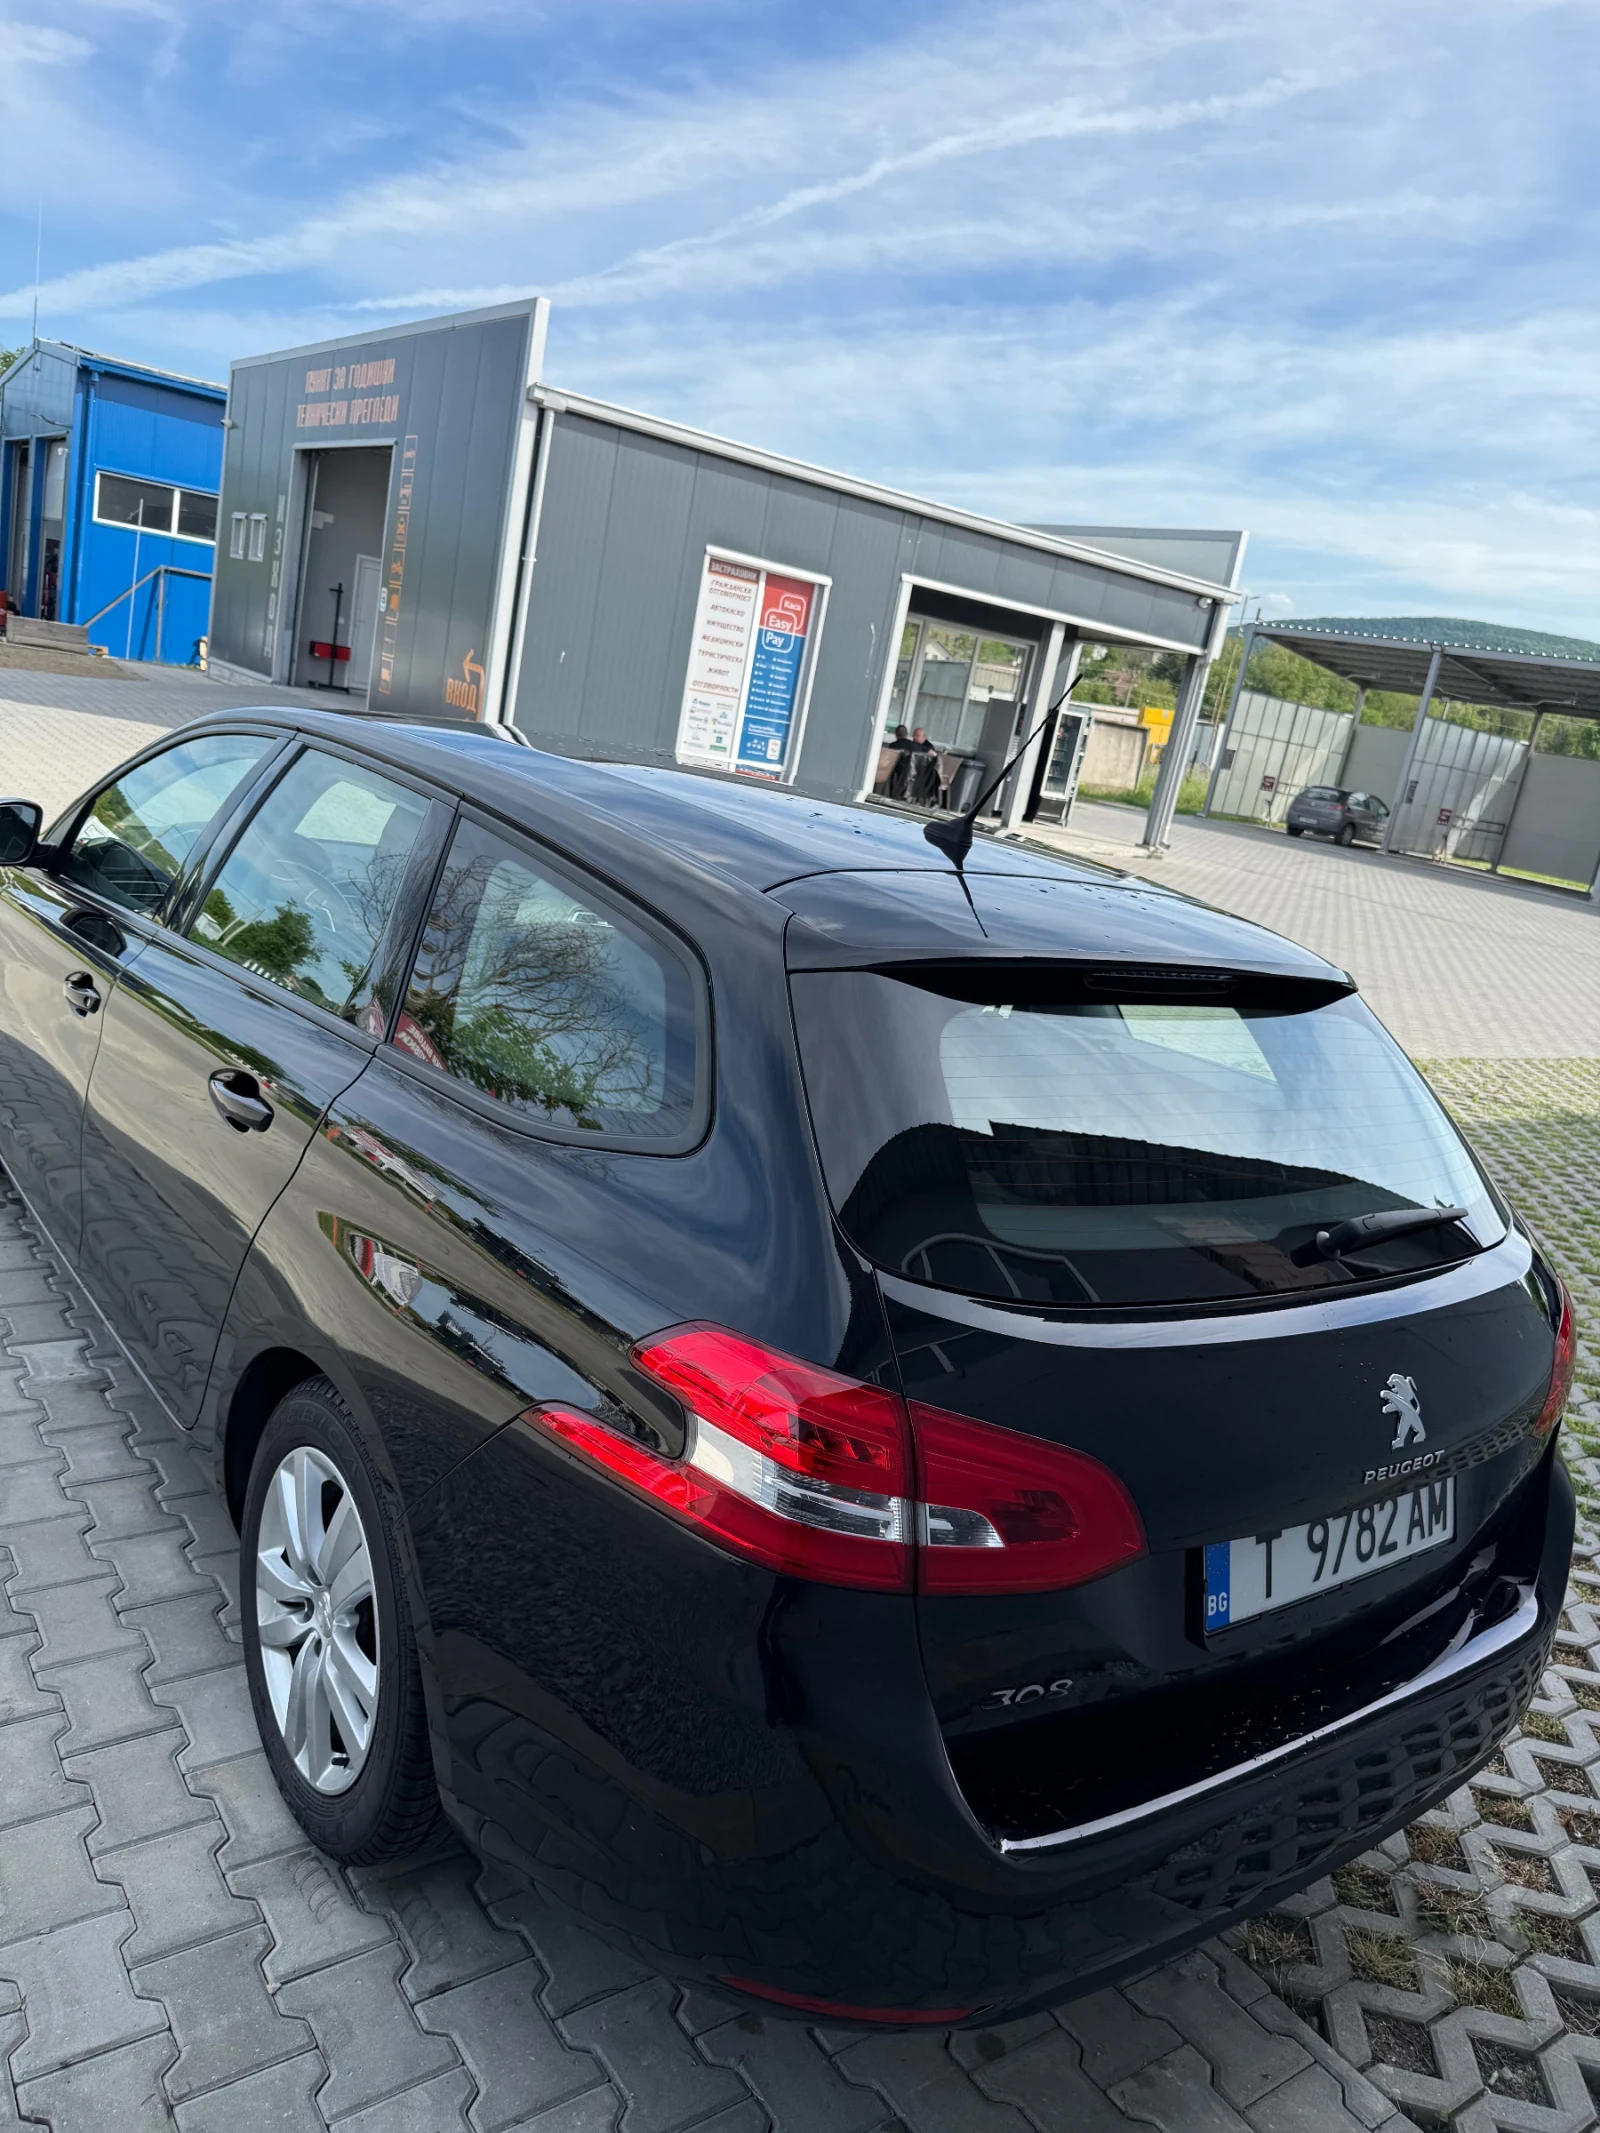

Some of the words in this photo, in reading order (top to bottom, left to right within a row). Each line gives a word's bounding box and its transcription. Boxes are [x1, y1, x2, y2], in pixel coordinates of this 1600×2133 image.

[333, 366, 346, 390] ЗА
[348, 358, 395, 389] ГОДИШНИ
[768, 614, 793, 632] Easy
[765, 631, 785, 648] Pay
[446, 678, 476, 712] ВХОД
[1363, 1450, 1446, 1485] PEUGEOT
[1255, 1530, 1283, 1599] T
[1307, 1500, 1398, 1583] 9782
[1406, 1475, 1448, 1546] AM
[1207, 1591, 1228, 1617] BG
[981, 1679, 1073, 1710] 308
